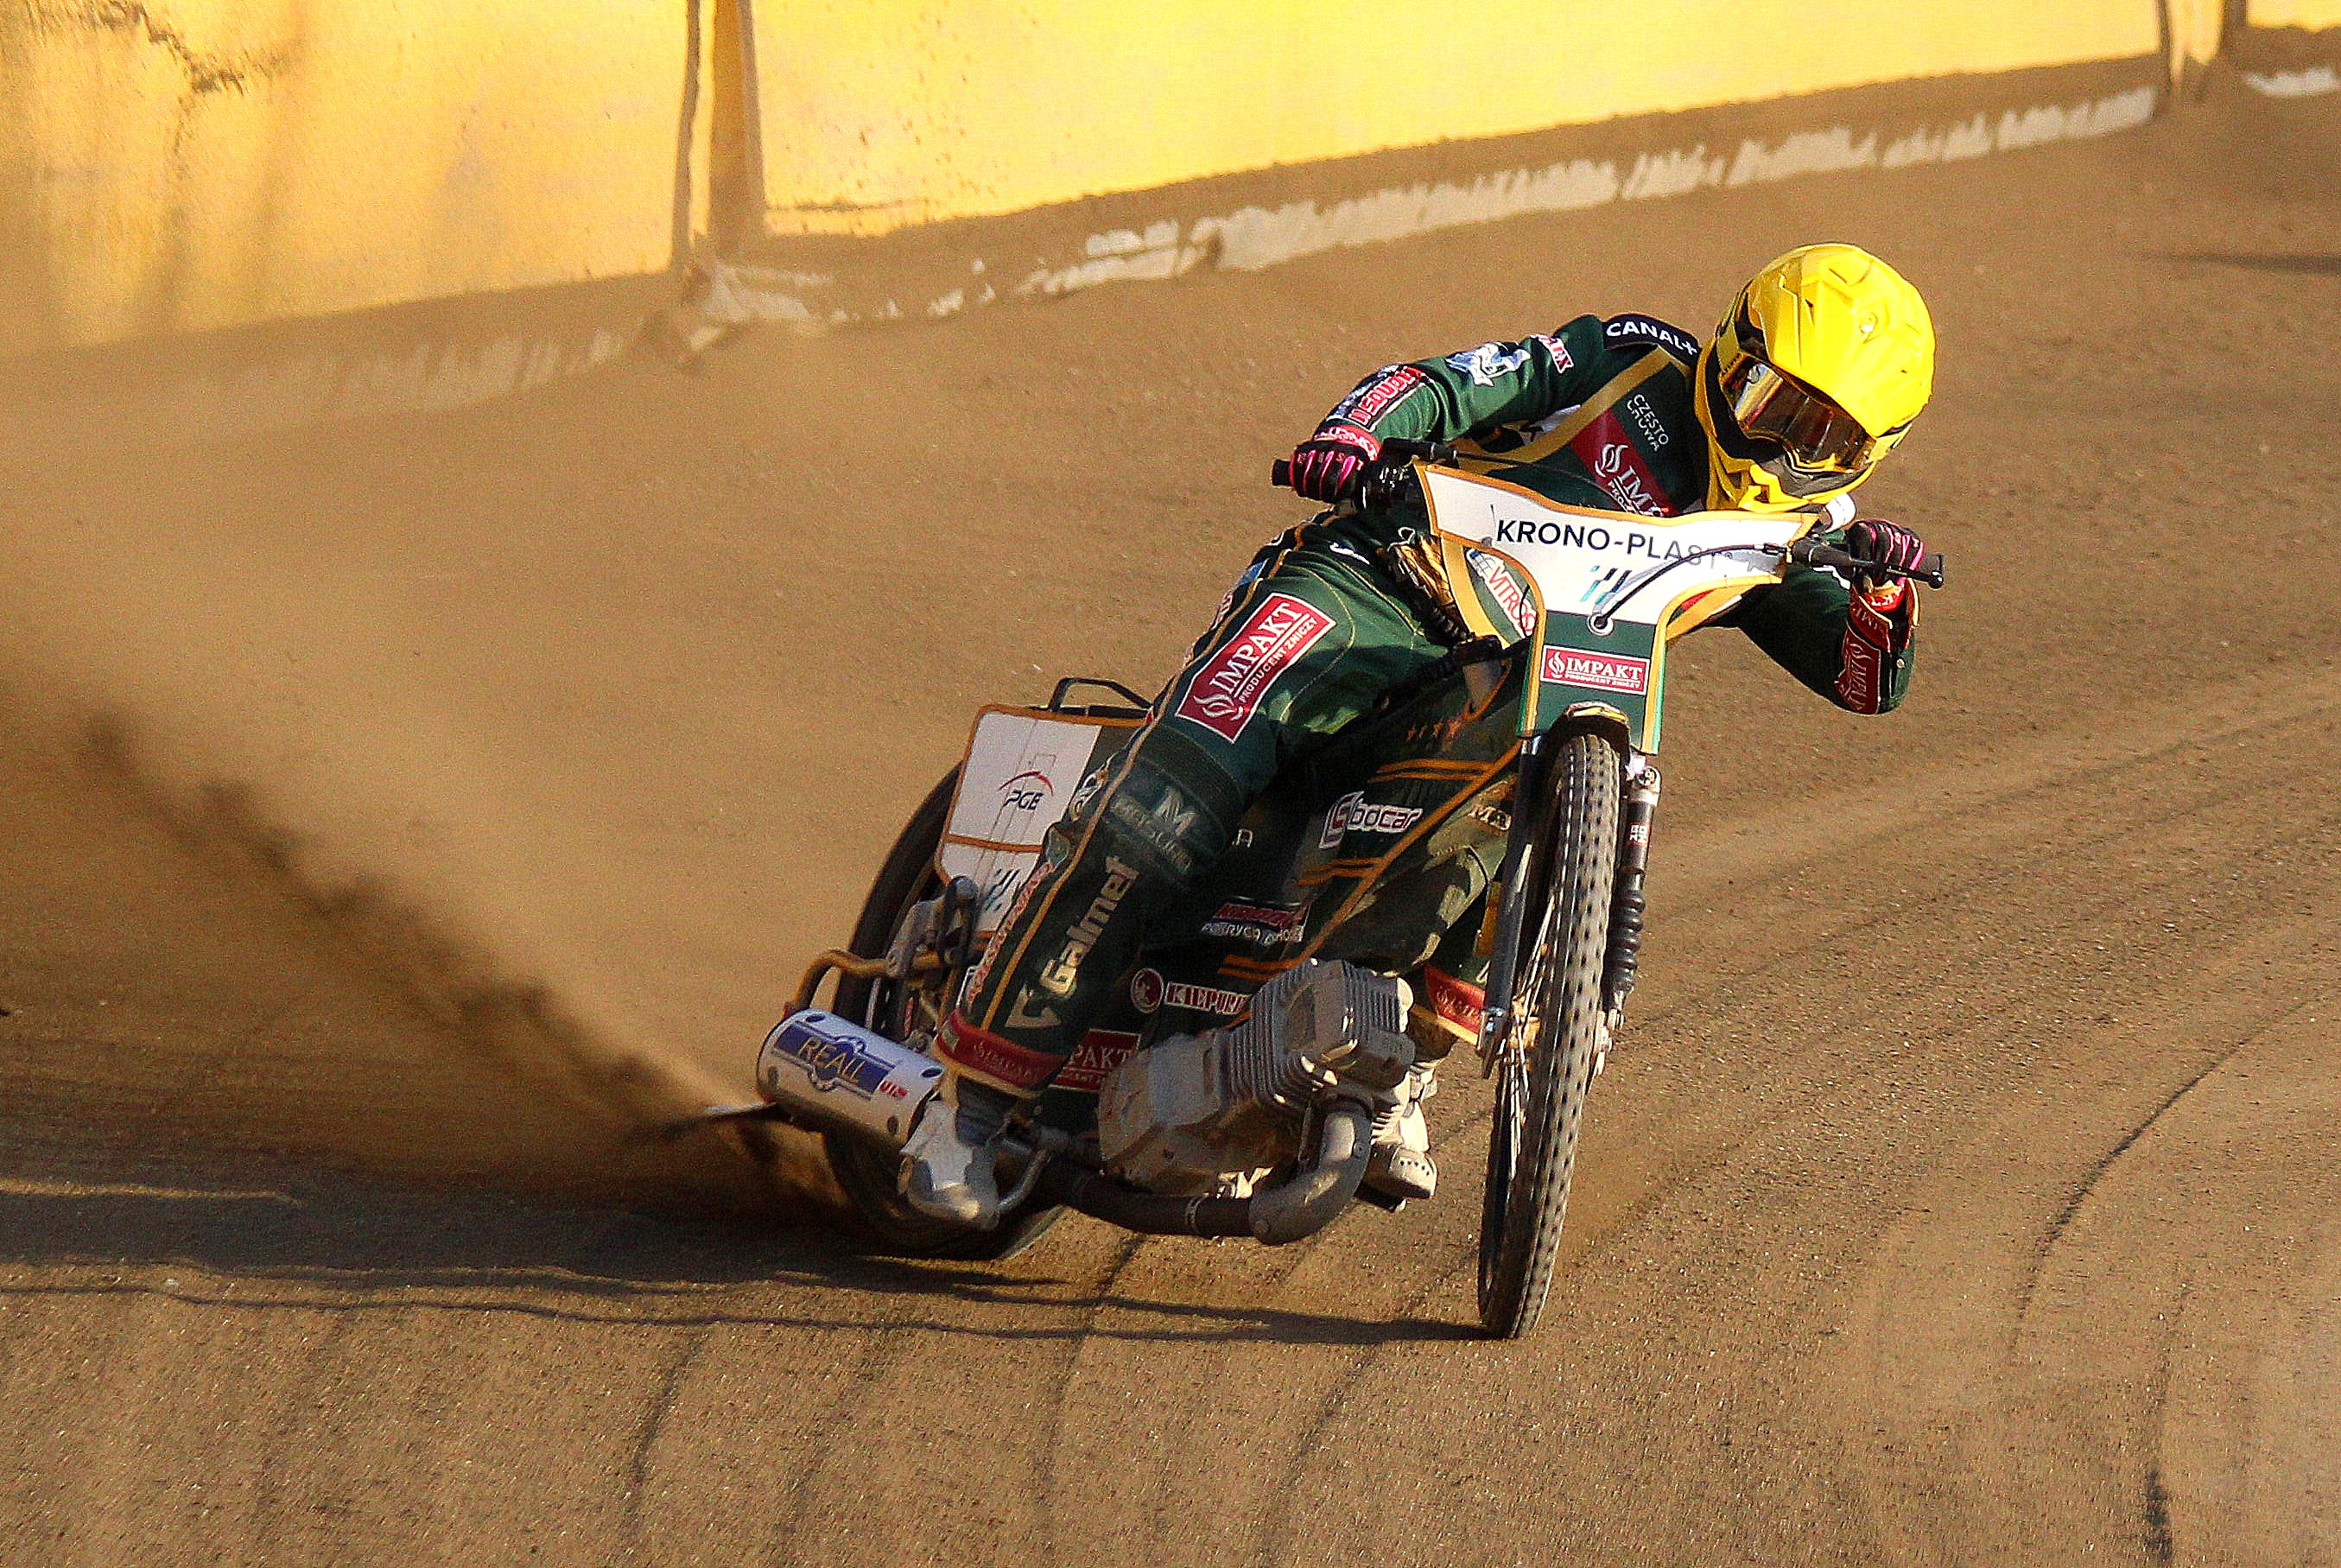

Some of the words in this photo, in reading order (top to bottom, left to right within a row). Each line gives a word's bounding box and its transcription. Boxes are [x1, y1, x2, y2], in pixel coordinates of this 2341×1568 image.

[1209, 602, 1299, 694] IMPAKT
[1565, 657, 1643, 682] IMPAKT
[1003, 790, 1044, 812] PGE
[1040, 855, 1140, 995] Galmet
